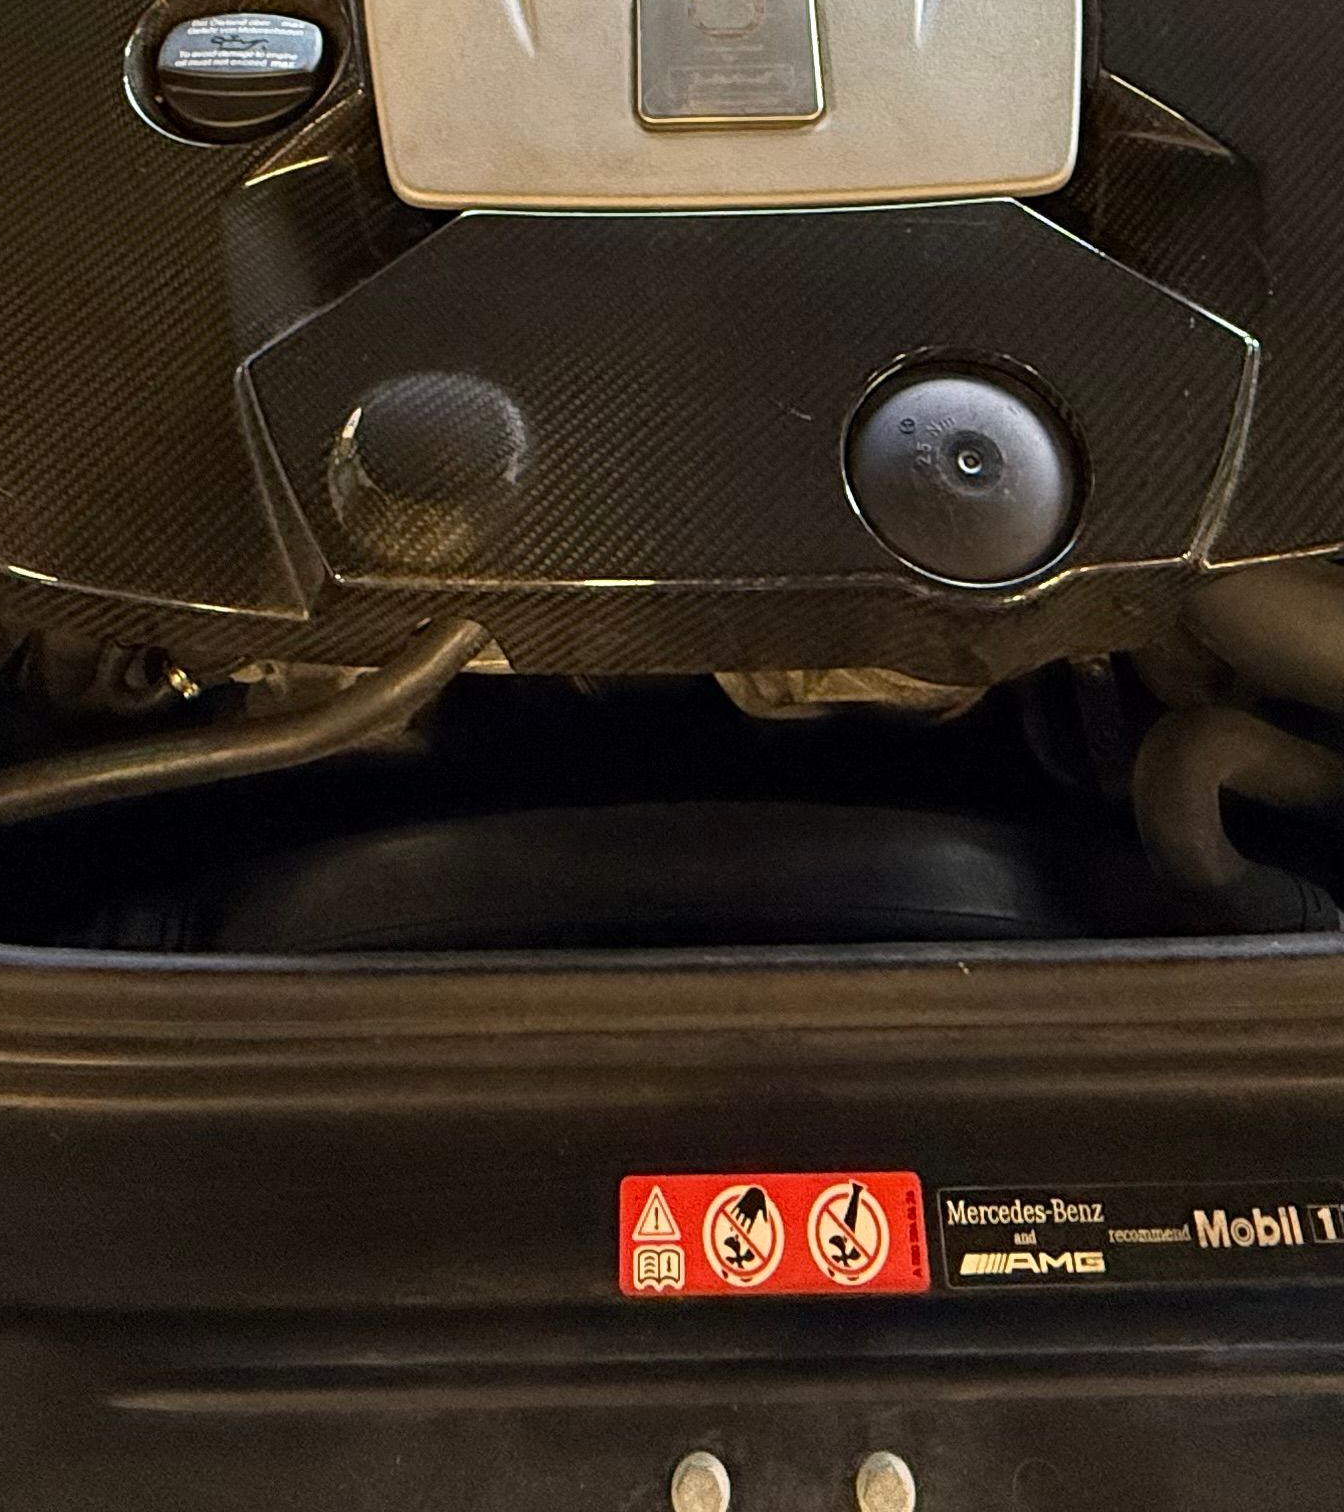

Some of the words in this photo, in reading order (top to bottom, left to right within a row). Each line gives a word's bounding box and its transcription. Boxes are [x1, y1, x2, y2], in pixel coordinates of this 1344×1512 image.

[947, 1198, 1105, 1226] Mercedes-Benz
[1109, 1224, 1192, 1244] recommend
[1194, 1205, 1305, 1249] Mobil
[1013, 1229, 1037, 1246] and
[1005, 1251, 1106, 1274] AMG
